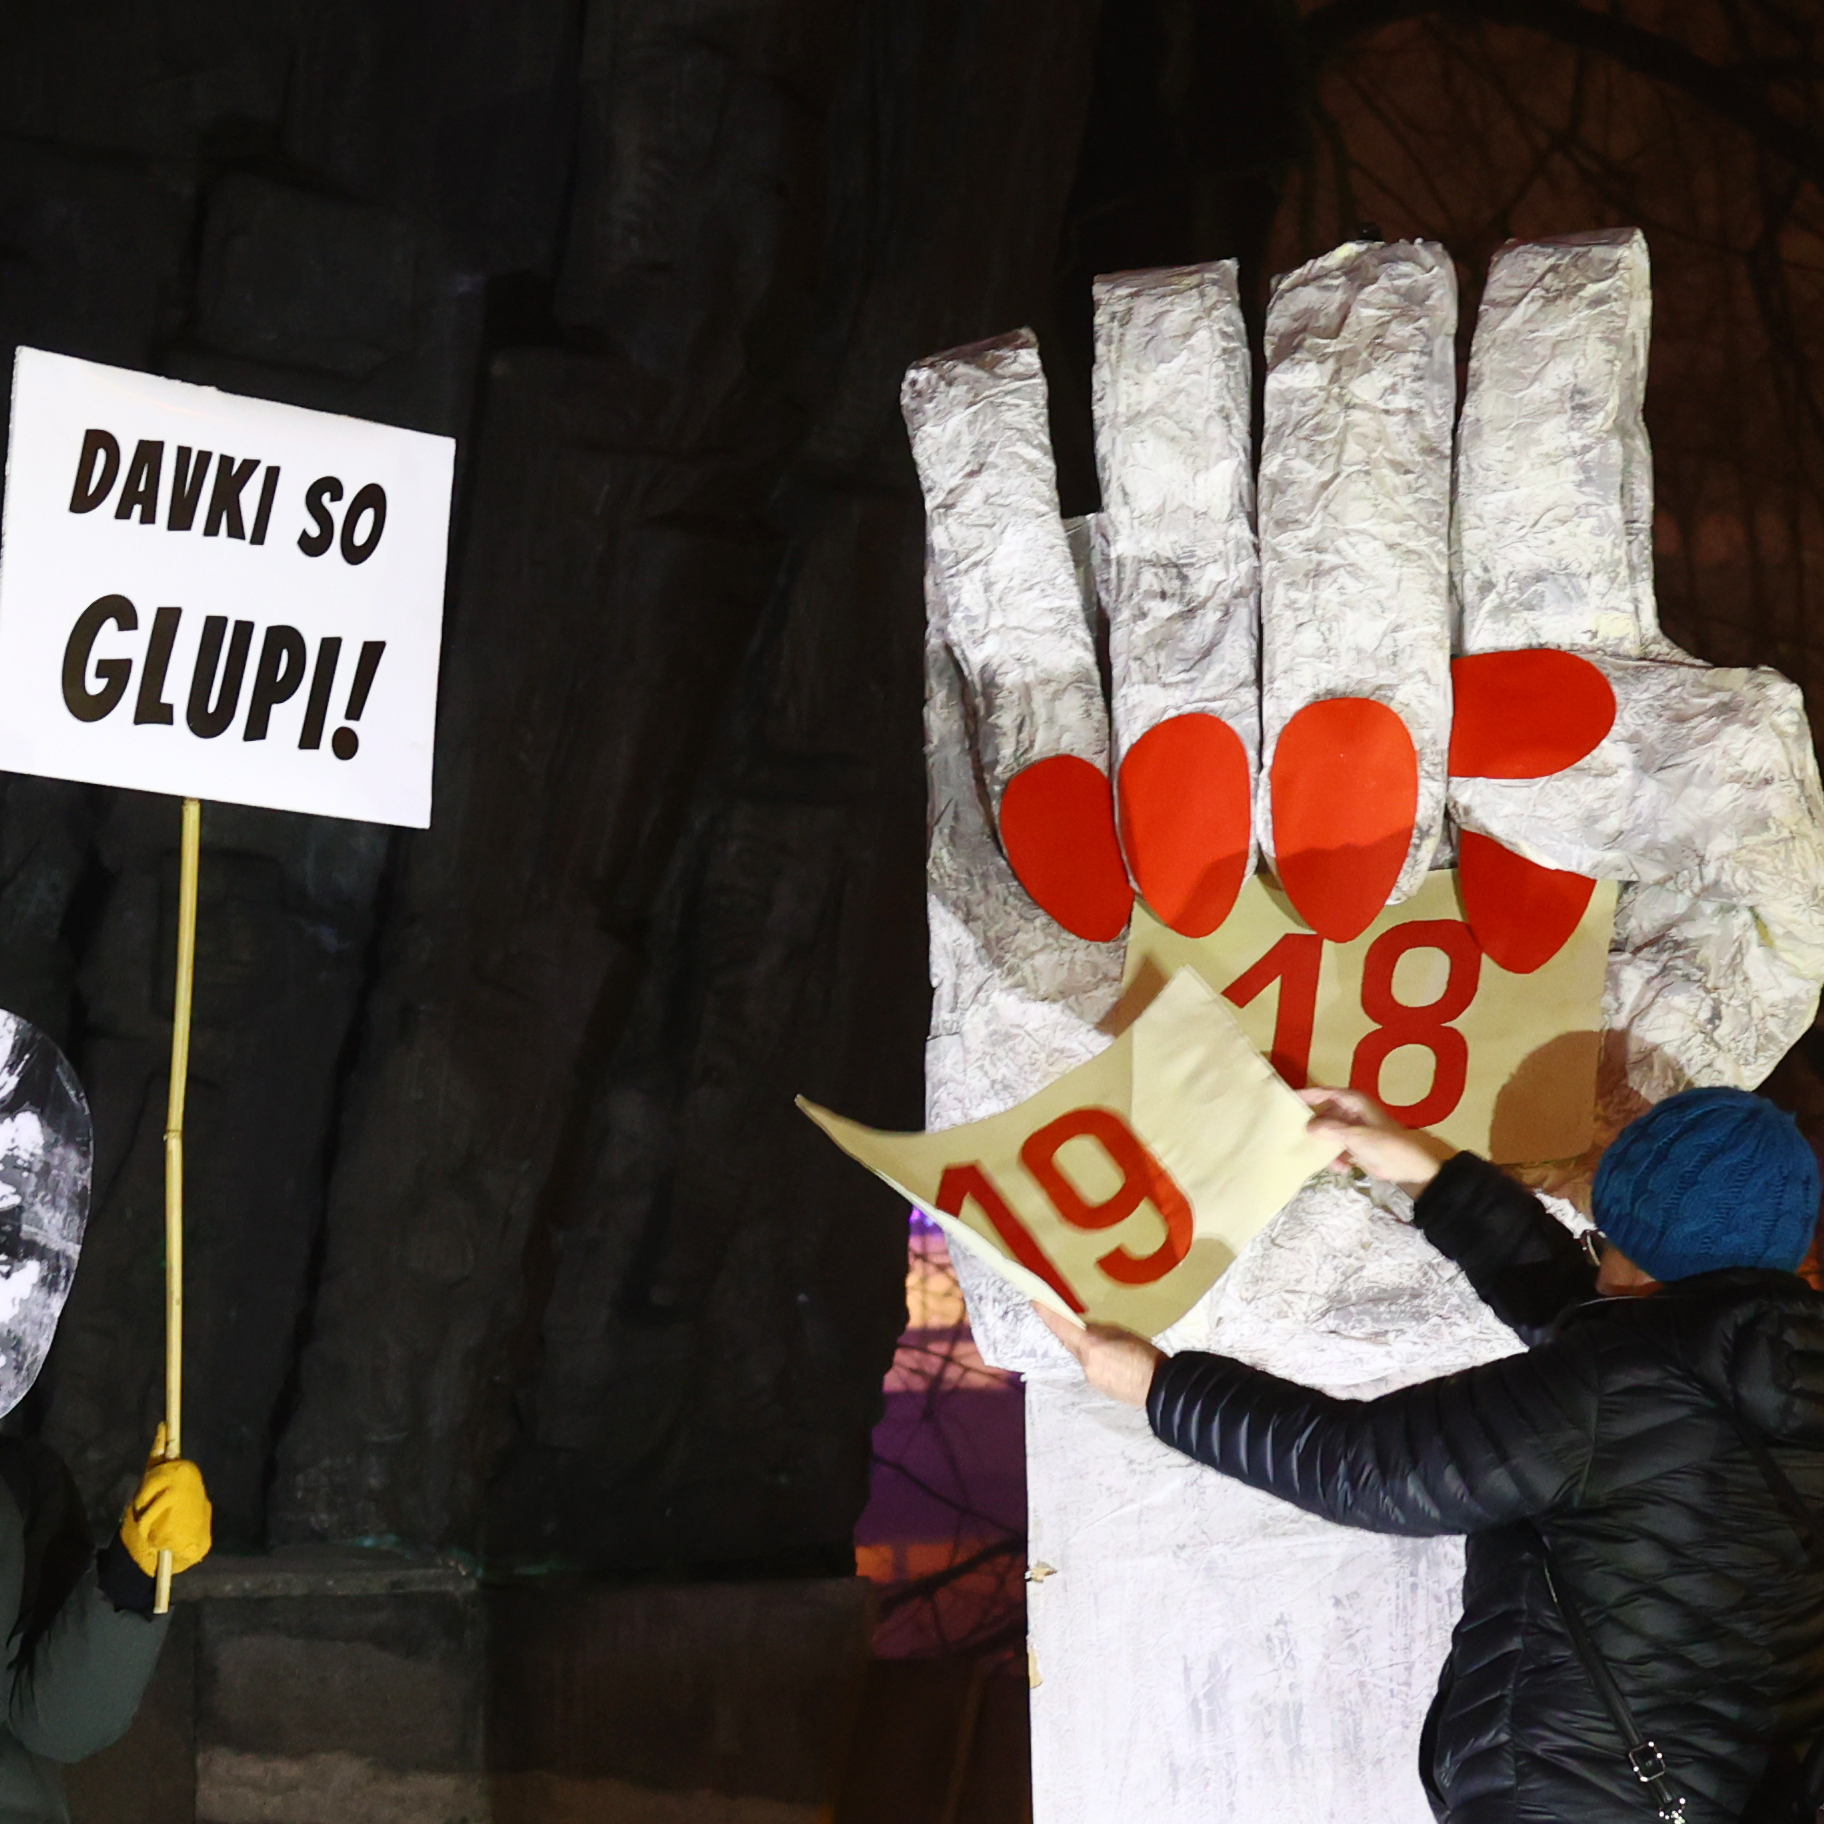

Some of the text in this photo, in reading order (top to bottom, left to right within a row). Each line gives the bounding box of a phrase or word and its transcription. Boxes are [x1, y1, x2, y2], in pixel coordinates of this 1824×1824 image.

[68, 428, 387, 566] DAVKI SO
[61, 594, 386, 761] GLUPI!
[1223, 918, 1481, 1130] 18
[933, 1106, 1194, 1315] 19
